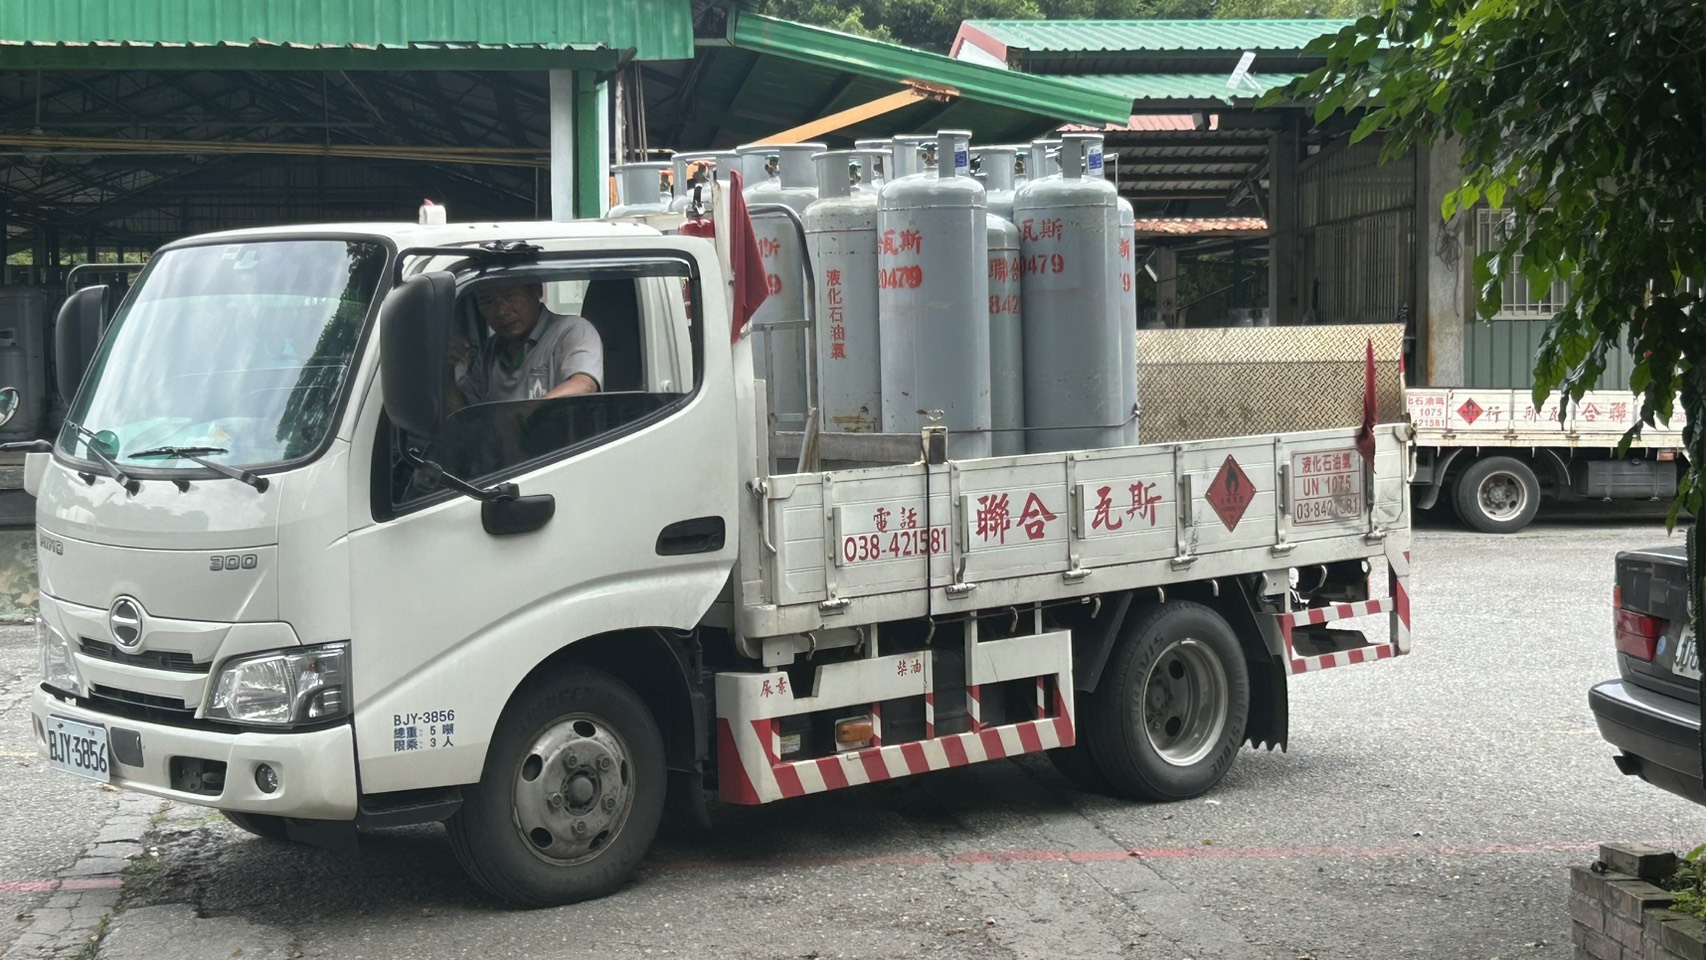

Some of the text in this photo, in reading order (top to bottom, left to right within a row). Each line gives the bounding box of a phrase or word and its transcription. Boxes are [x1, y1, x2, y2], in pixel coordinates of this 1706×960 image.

[879, 229, 923, 256] 瓦斯
[879, 265, 923, 289] 0479
[826, 269, 846, 360] 液化石油氣
[1420, 408, 1442, 416] 1075
[1415, 419, 1445, 427] 21581
[1302, 453, 1351, 474] 液化石油氣
[1303, 474, 1351, 496] UN 1075
[873, 507, 917, 533] 電話
[844, 527, 947, 562] 038-421581
[209, 554, 257, 571] 300
[897, 659, 922, 677] 柴油
[760, 677, 787, 697] 尿素
[393, 709, 455, 727] BJY-3856
[429, 725, 437, 736] 5
[429, 737, 437, 748] 3
[442, 736, 454, 748] 人
